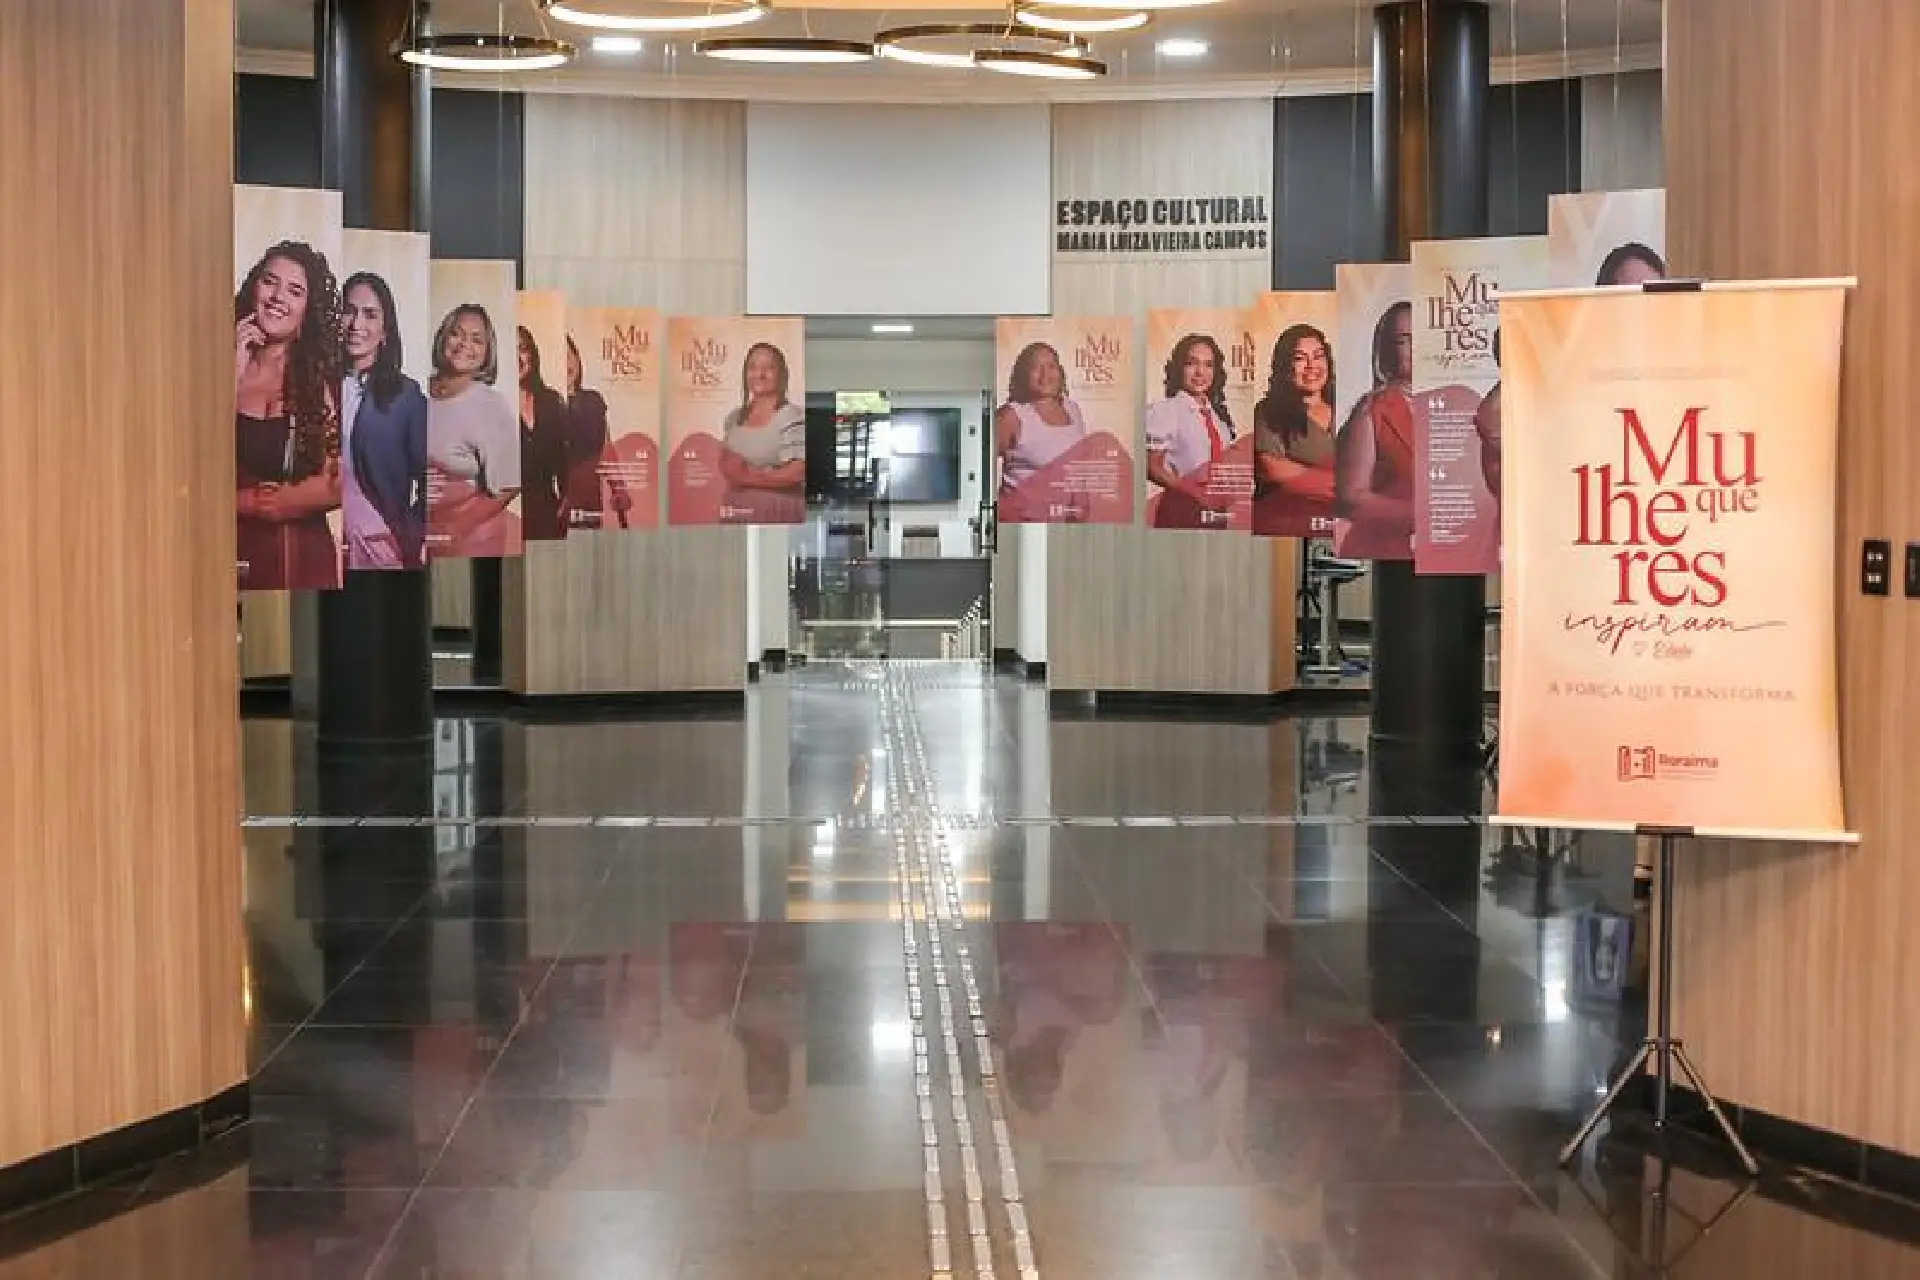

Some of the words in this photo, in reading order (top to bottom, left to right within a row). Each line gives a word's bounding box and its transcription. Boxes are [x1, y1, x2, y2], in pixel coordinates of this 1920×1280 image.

[1057, 199, 1147, 230] ESPAÇO
[1153, 196, 1268, 225] CULTURAL
[1057, 231, 1107, 252] MARIA
[1110, 231, 1151, 252] LUIZA
[1152, 231, 1201, 252] VIEIRA
[1205, 230, 1267, 250] CAMPOS
[1613, 405, 1763, 488] Mu
[1571, 463, 1689, 546] lhe
[1696, 488, 1758, 523] que
[1612, 550, 1728, 607] res
[1563, 614, 1788, 655] inspiram
